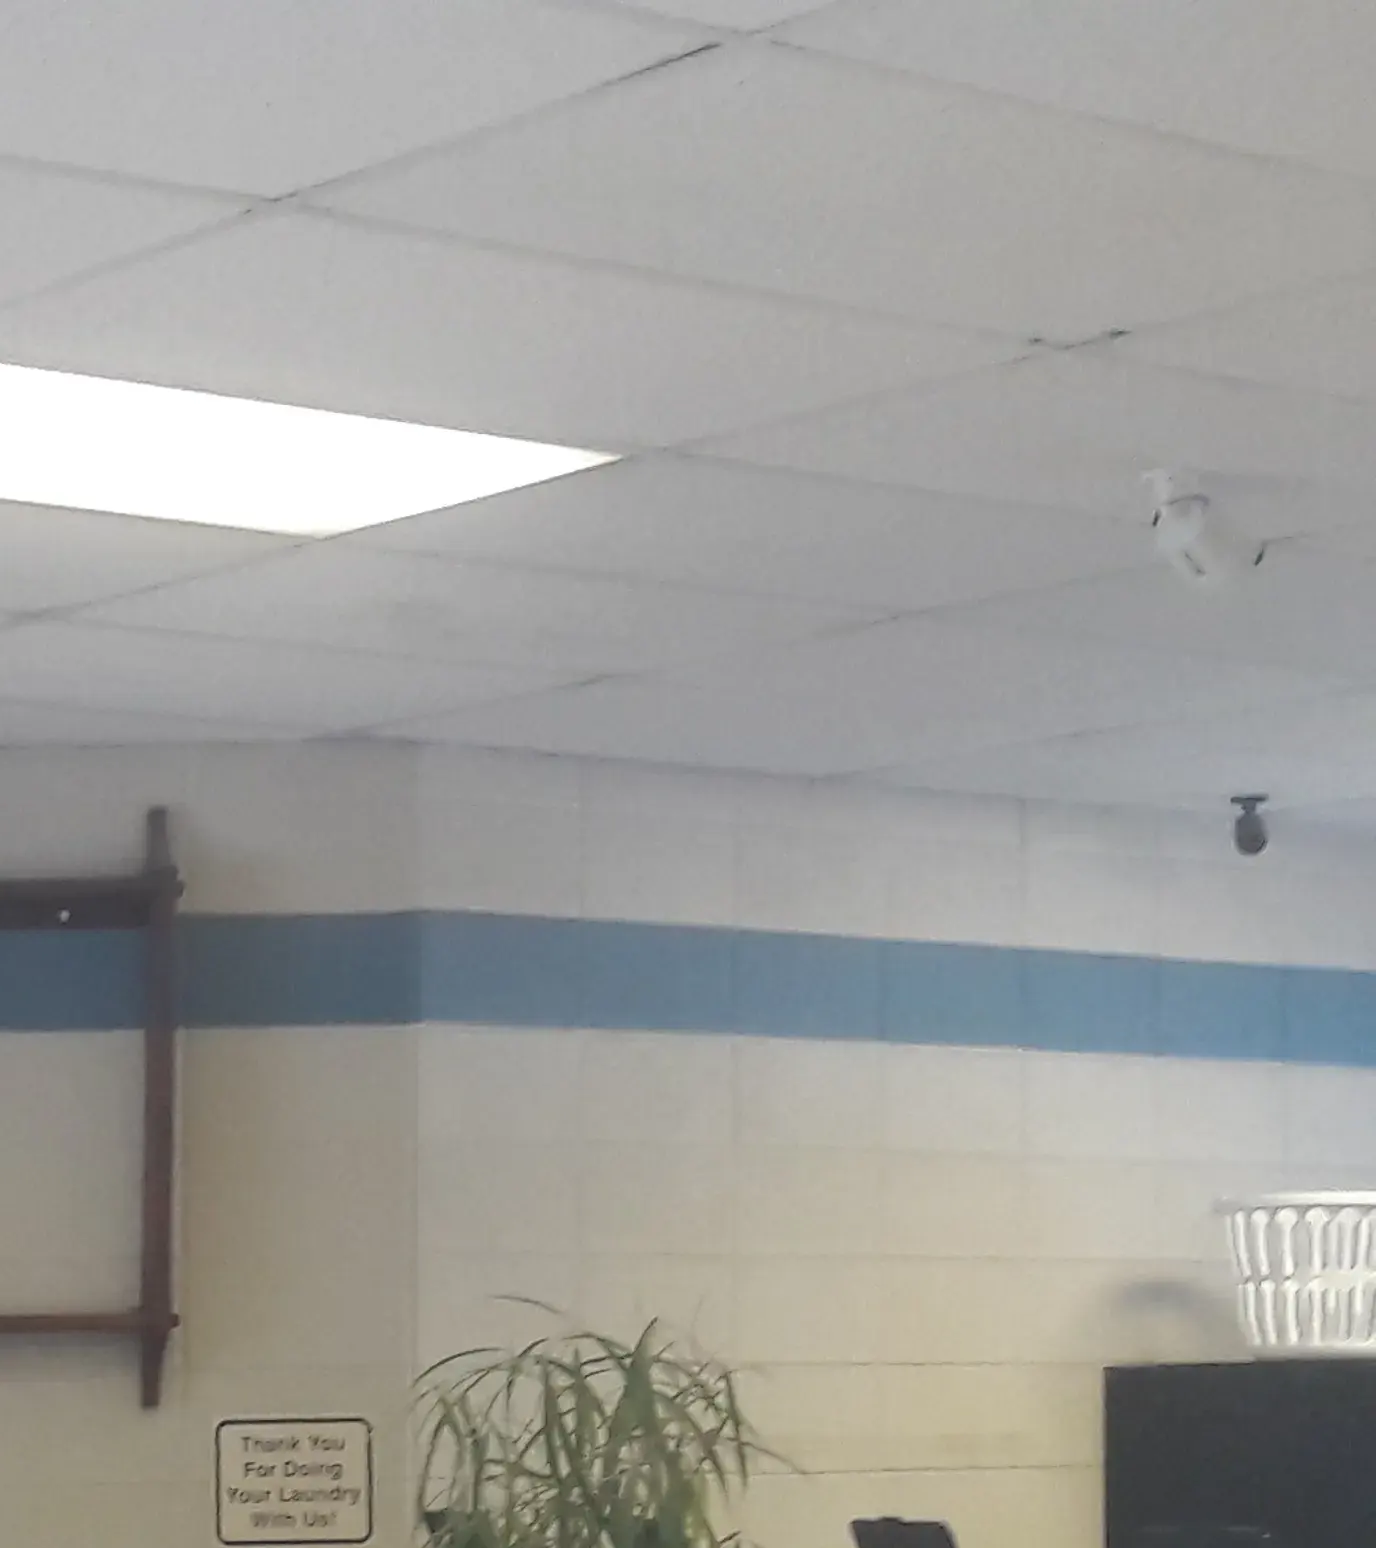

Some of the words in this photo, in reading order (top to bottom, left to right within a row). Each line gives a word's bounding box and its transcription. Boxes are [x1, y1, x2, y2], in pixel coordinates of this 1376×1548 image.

[241, 1436, 300, 1452] Thank
[307, 1435, 346, 1451] You
[244, 1461, 276, 1478] For
[284, 1460, 343, 1480] Doing
[227, 1486, 272, 1503] Your
[279, 1486, 362, 1505] Laundry
[250, 1511, 297, 1527] With
